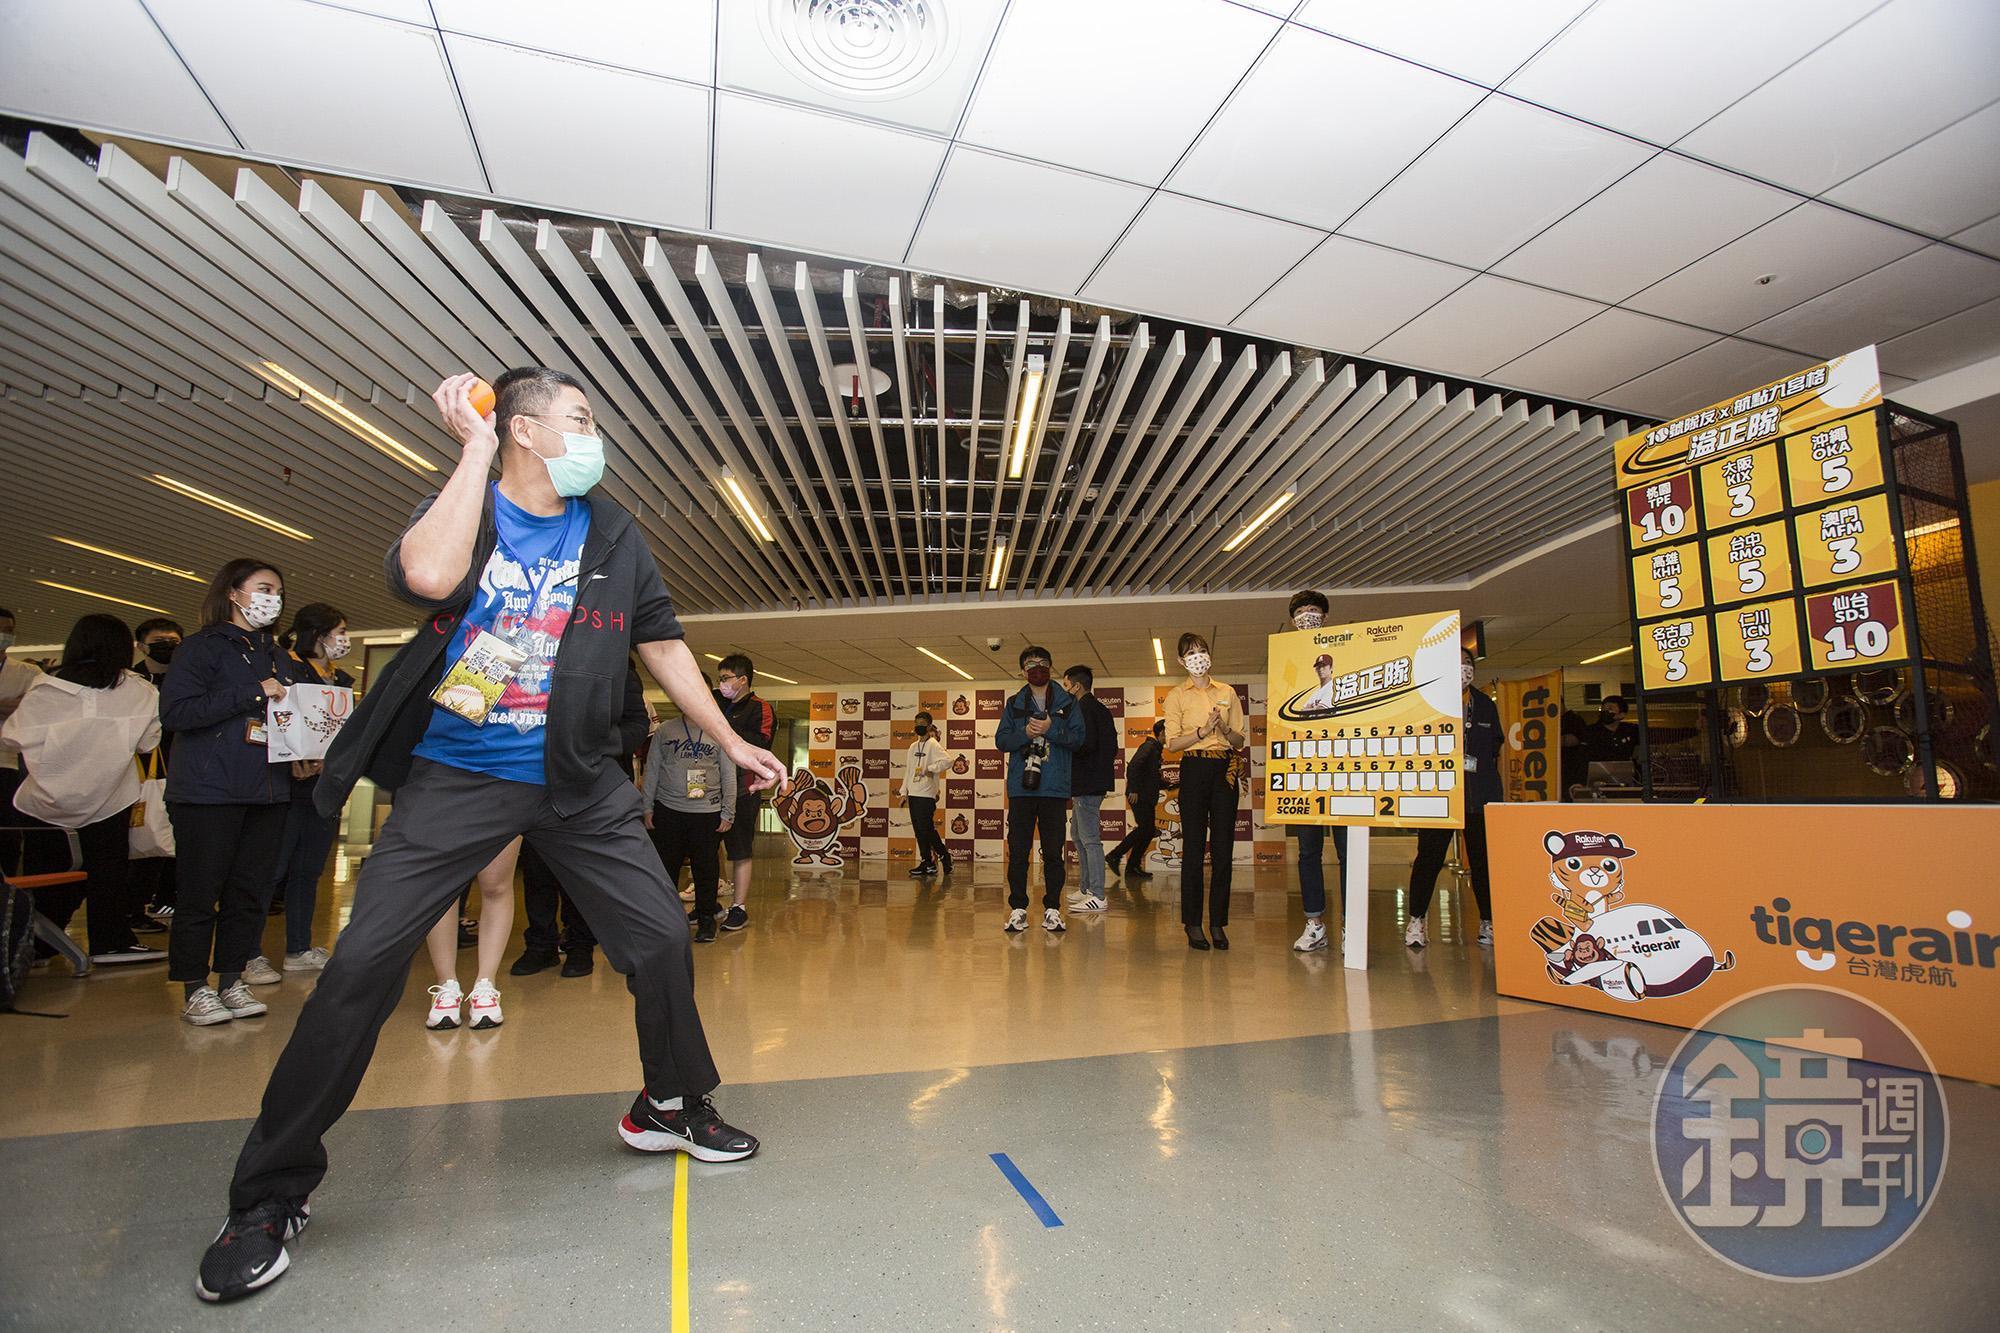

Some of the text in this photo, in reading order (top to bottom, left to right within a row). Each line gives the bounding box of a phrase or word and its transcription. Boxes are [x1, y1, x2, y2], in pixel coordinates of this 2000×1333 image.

[1733, 367, 1828, 414] 航點九宮格
[1687, 407, 1781, 462] 溢正隊
[1811, 426, 1848, 448] 沖繩
[1812, 445, 1852, 461] OKA
[1722, 455, 1753, 475] 大阪
[1821, 456, 1853, 493] 5
[1726, 472, 1752, 486] KIX
[1646, 482, 1672, 500] 桃園
[1729, 484, 1755, 517] 3
[1647, 496, 1672, 509] TPE
[1640, 504, 1685, 542] 10
[1820, 506, 1858, 527] 澳門
[1821, 521, 1864, 541] MFM
[1730, 533, 1762, 550] 台中
[1652, 551, 1680, 569] 高雄
[1729, 546, 1766, 563] RMQ
[1827, 537, 1861, 574] 3
[1652, 564, 1682, 580] KHH
[1738, 560, 1766, 593] 5
[1659, 577, 1682, 608] 5
[1832, 592, 1870, 612] 仙台
[1738, 609, 1770, 628] 仁川
[1835, 609, 1871, 624] SDJ
[1313, 624, 1404, 648] tigerair Rakuten
[1652, 622, 1694, 640] 名古屋
[1741, 624, 1770, 639] ICN
[1657, 637, 1690, 651] NGO
[1823, 621, 1889, 662] 10
[1744, 638, 1773, 672] 3
[1663, 650, 1687, 682] 3
[1332, 656, 1413, 706] 溢正隊
[1291, 723, 1454, 739] 1 2 3 4 5 6 7 8 9 10
[1273, 743, 1282, 758] 1
[1290, 759, 1455, 771] 1 2 3 4 5 6 7 8 9 10
[1272, 775, 1284, 789] 2
[1276, 796, 1311, 806] TOTAL
[1276, 806, 1310, 815] SCORE
[1316, 796, 1326, 815] 1
[1379, 796, 1395, 816] 2
[1575, 834, 1606, 846] Rakuten
[1750, 897, 2000, 971] tigerair
[1631, 936, 1681, 958] tigerair
[1846, 956, 1957, 988] 台灣虎航
